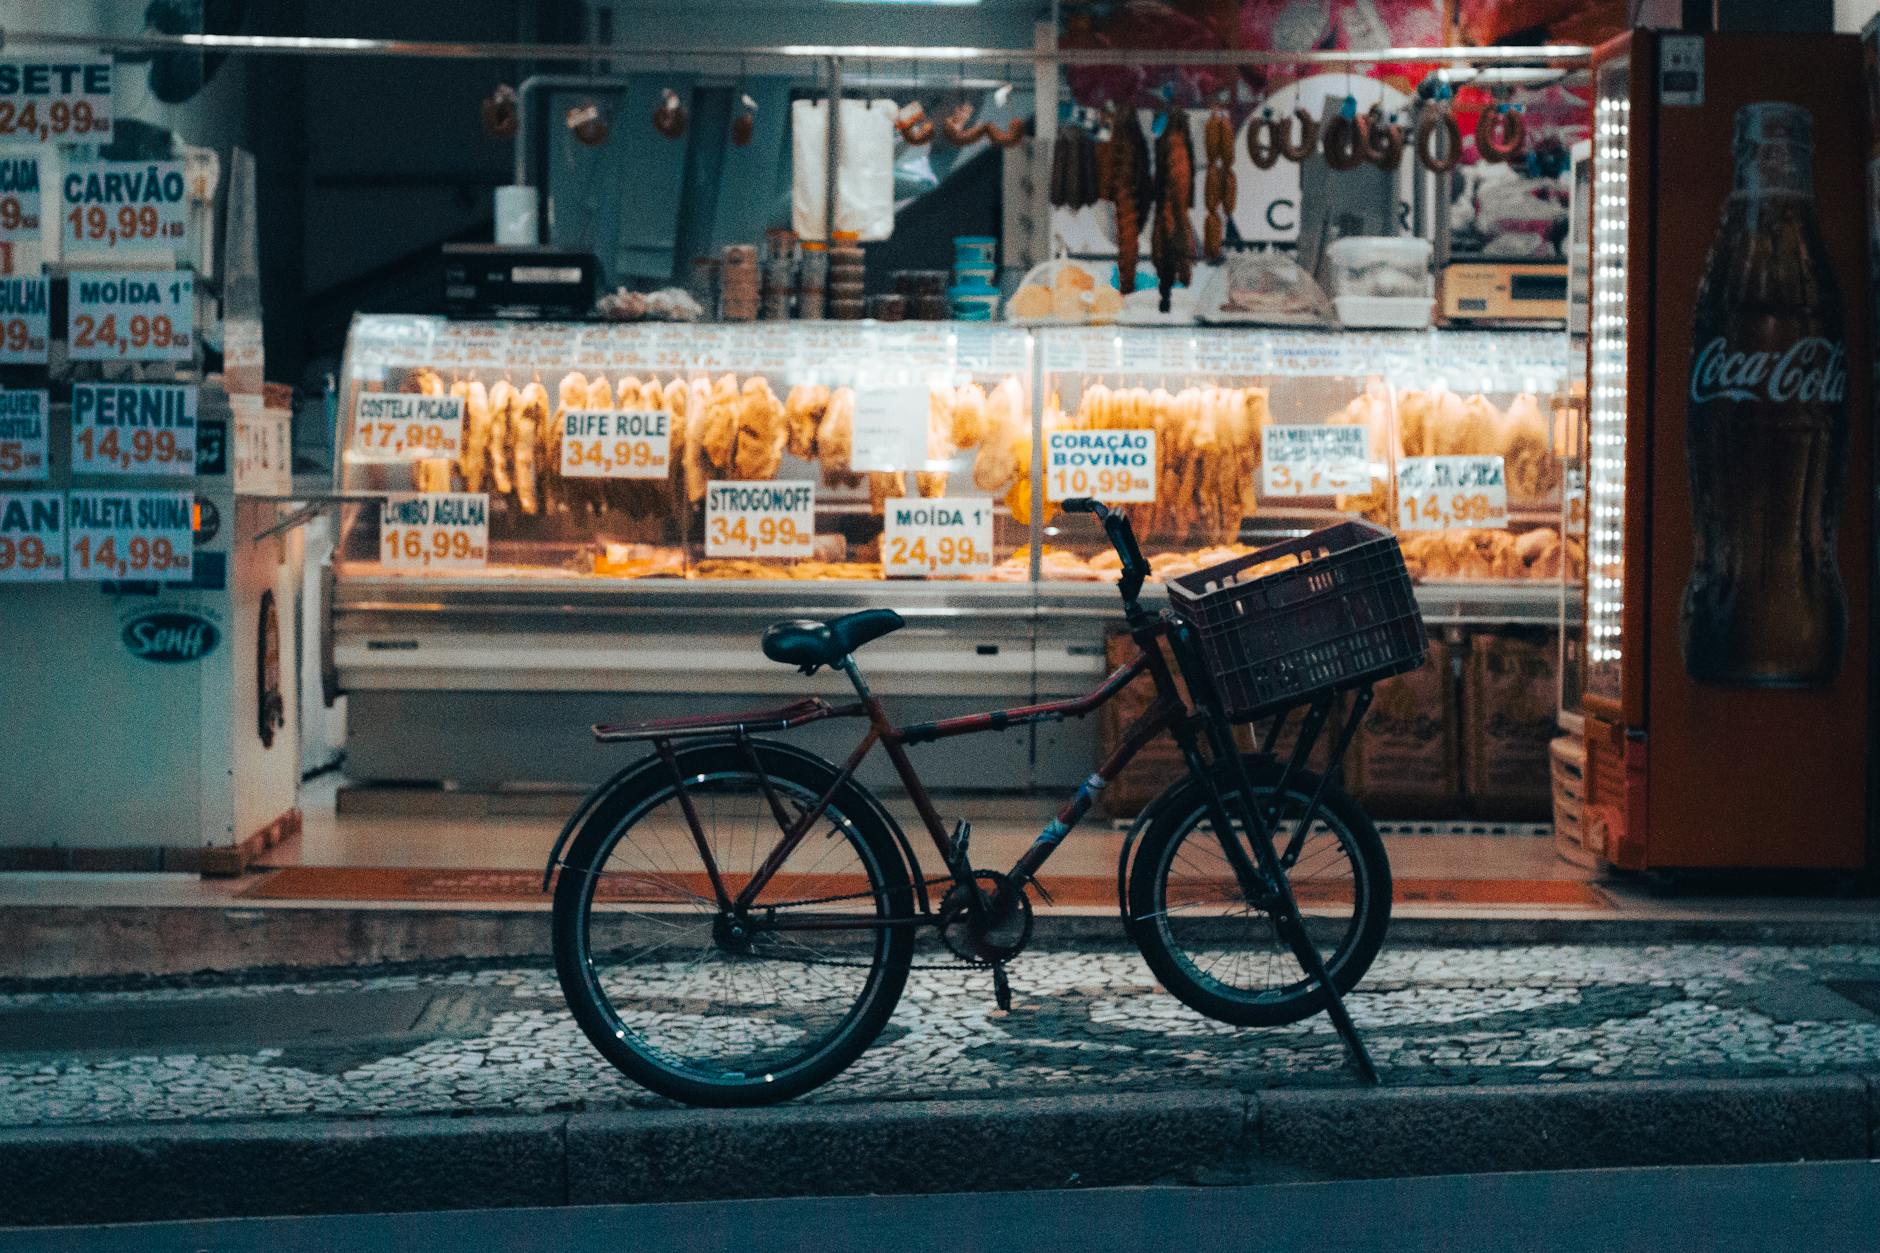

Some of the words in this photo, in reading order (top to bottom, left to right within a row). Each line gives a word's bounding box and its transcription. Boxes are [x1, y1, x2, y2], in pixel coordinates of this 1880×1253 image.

[0, 64, 111, 94] SETE
[0, 102, 93, 142] 24,99
[64, 165, 184, 203] CARVÃO
[67, 205, 159, 246] 19,99
[80, 278, 160, 304] MOÍDA
[74, 314, 173, 353] 24,99
[1691, 336, 1848, 403] Coca-Cola
[75, 388, 194, 427] PERNIL
[360, 422, 443, 453] 17,99
[566, 414, 609, 436] BIFE
[616, 414, 666, 437] ROLE
[79, 428, 175, 470] 14,99
[566, 440, 651, 472] 34,99
[1051, 433, 1148, 454] CORAÇÃO
[1053, 452, 1147, 467] BOVINO
[1054, 468, 1133, 497] 10,99
[71, 498, 132, 528] PALETA
[711, 487, 811, 511] STROGONOFF
[2, 500, 60, 532] AN
[896, 505, 964, 526] MOÍDA
[385, 529, 470, 565] 16,99
[711, 516, 796, 551] 34,99
[75, 535, 172, 576] 14,99
[890, 536, 975, 571] 24,99
